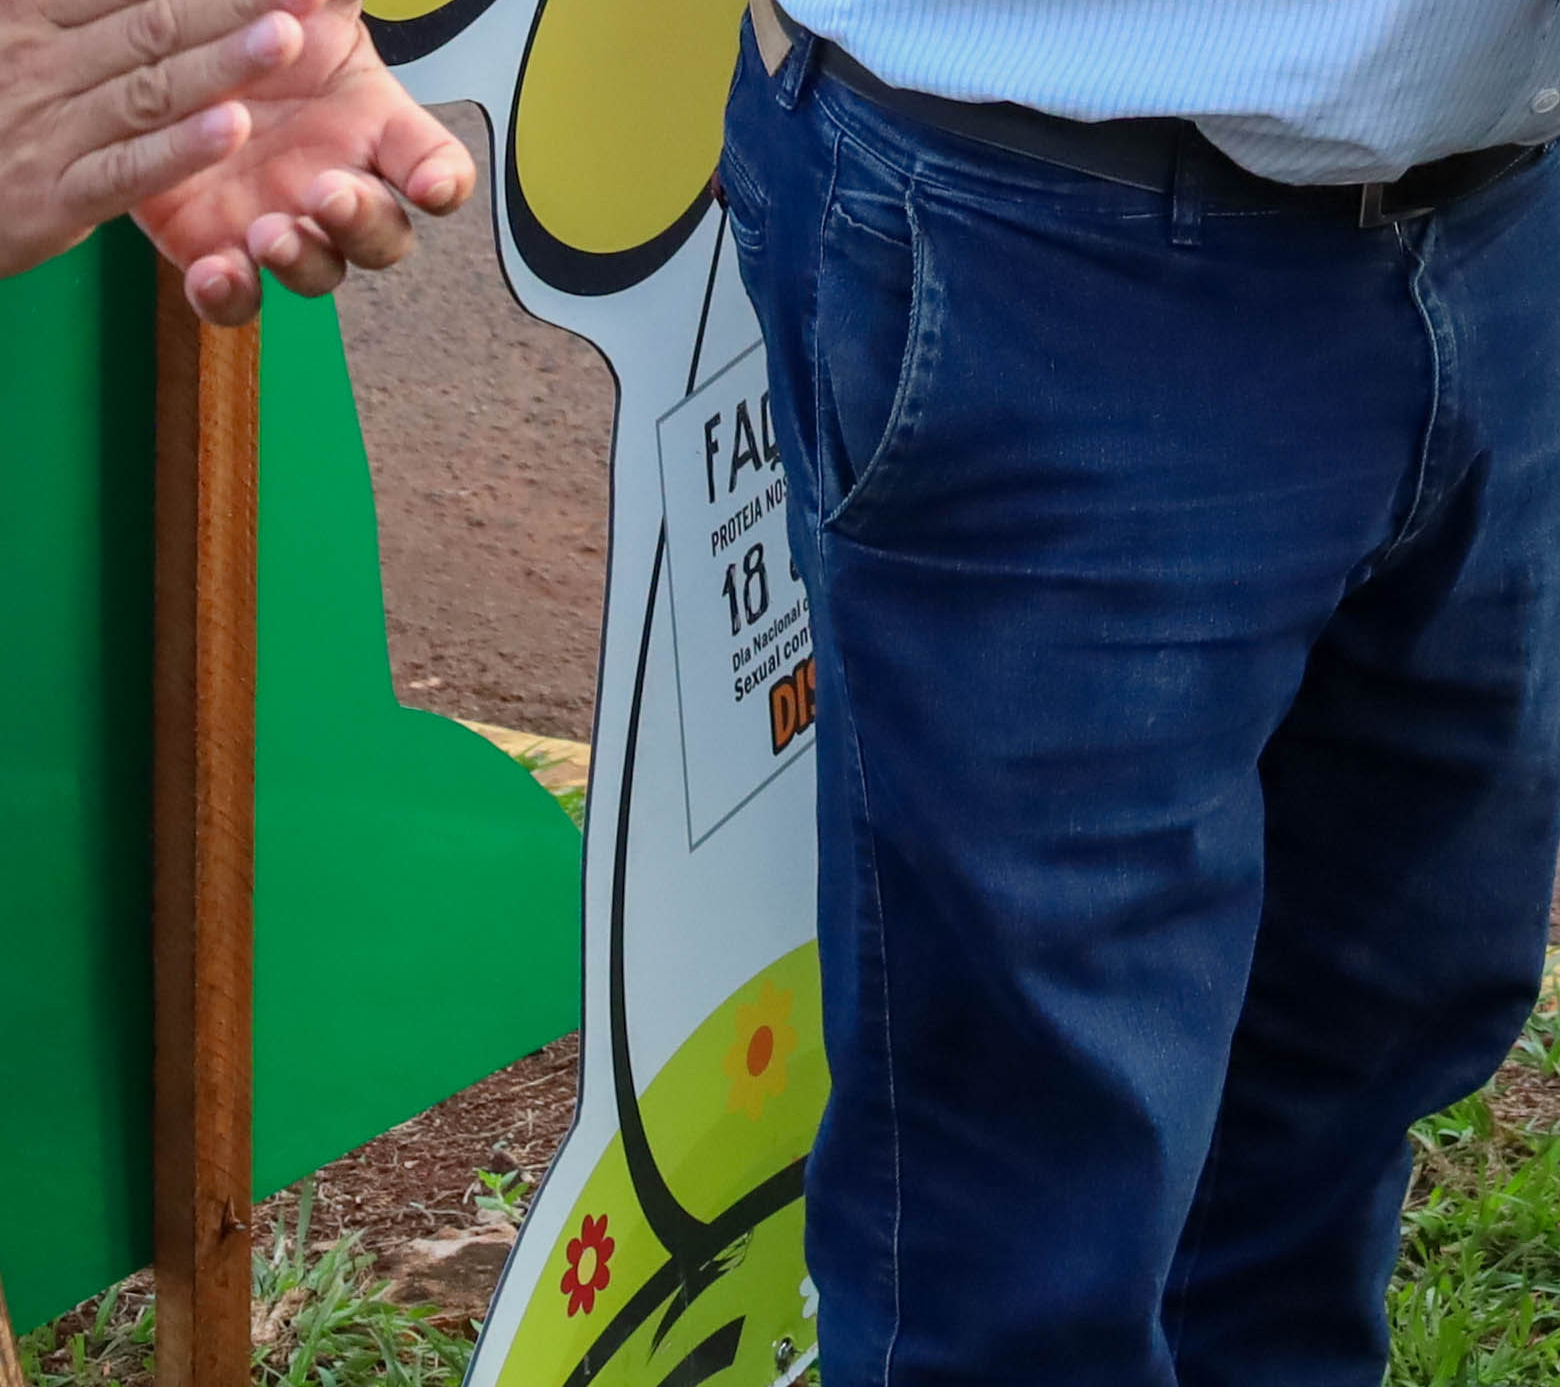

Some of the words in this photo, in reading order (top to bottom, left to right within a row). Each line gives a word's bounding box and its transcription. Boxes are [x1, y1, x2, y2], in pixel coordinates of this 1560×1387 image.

[711, 496, 763, 557] PROTEJA
[721, 542, 770, 637] 18
[732, 648, 751, 673] Dia
[753, 605, 801, 654] Nacional
[734, 642, 780, 702] Sexual
